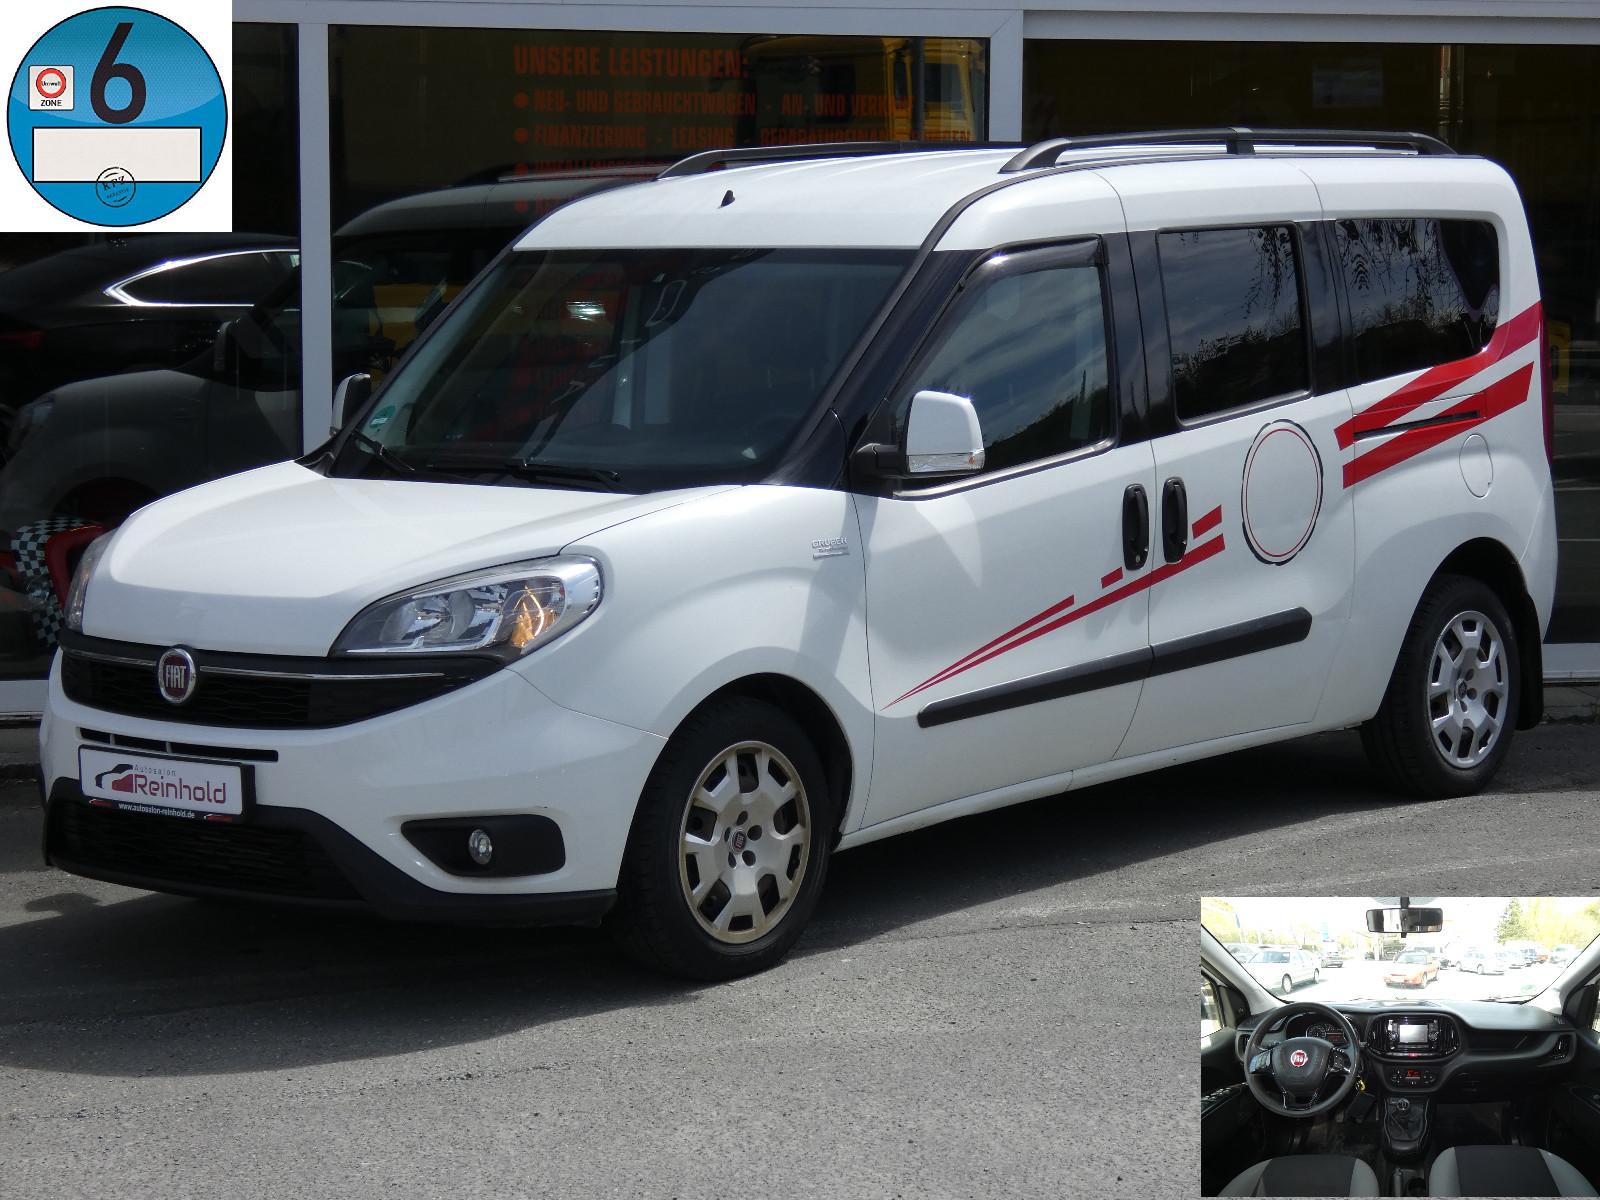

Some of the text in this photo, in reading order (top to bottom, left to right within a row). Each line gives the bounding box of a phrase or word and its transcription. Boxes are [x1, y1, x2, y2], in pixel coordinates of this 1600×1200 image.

[513, 45, 601, 75] UNSERE
[165, 664, 187, 689] FIAT
[134, 764, 177, 777] Autosalon
[134, 773, 227, 804] Reinhold
[118, 801, 196, 819] www.autosalon-reinhold.de
